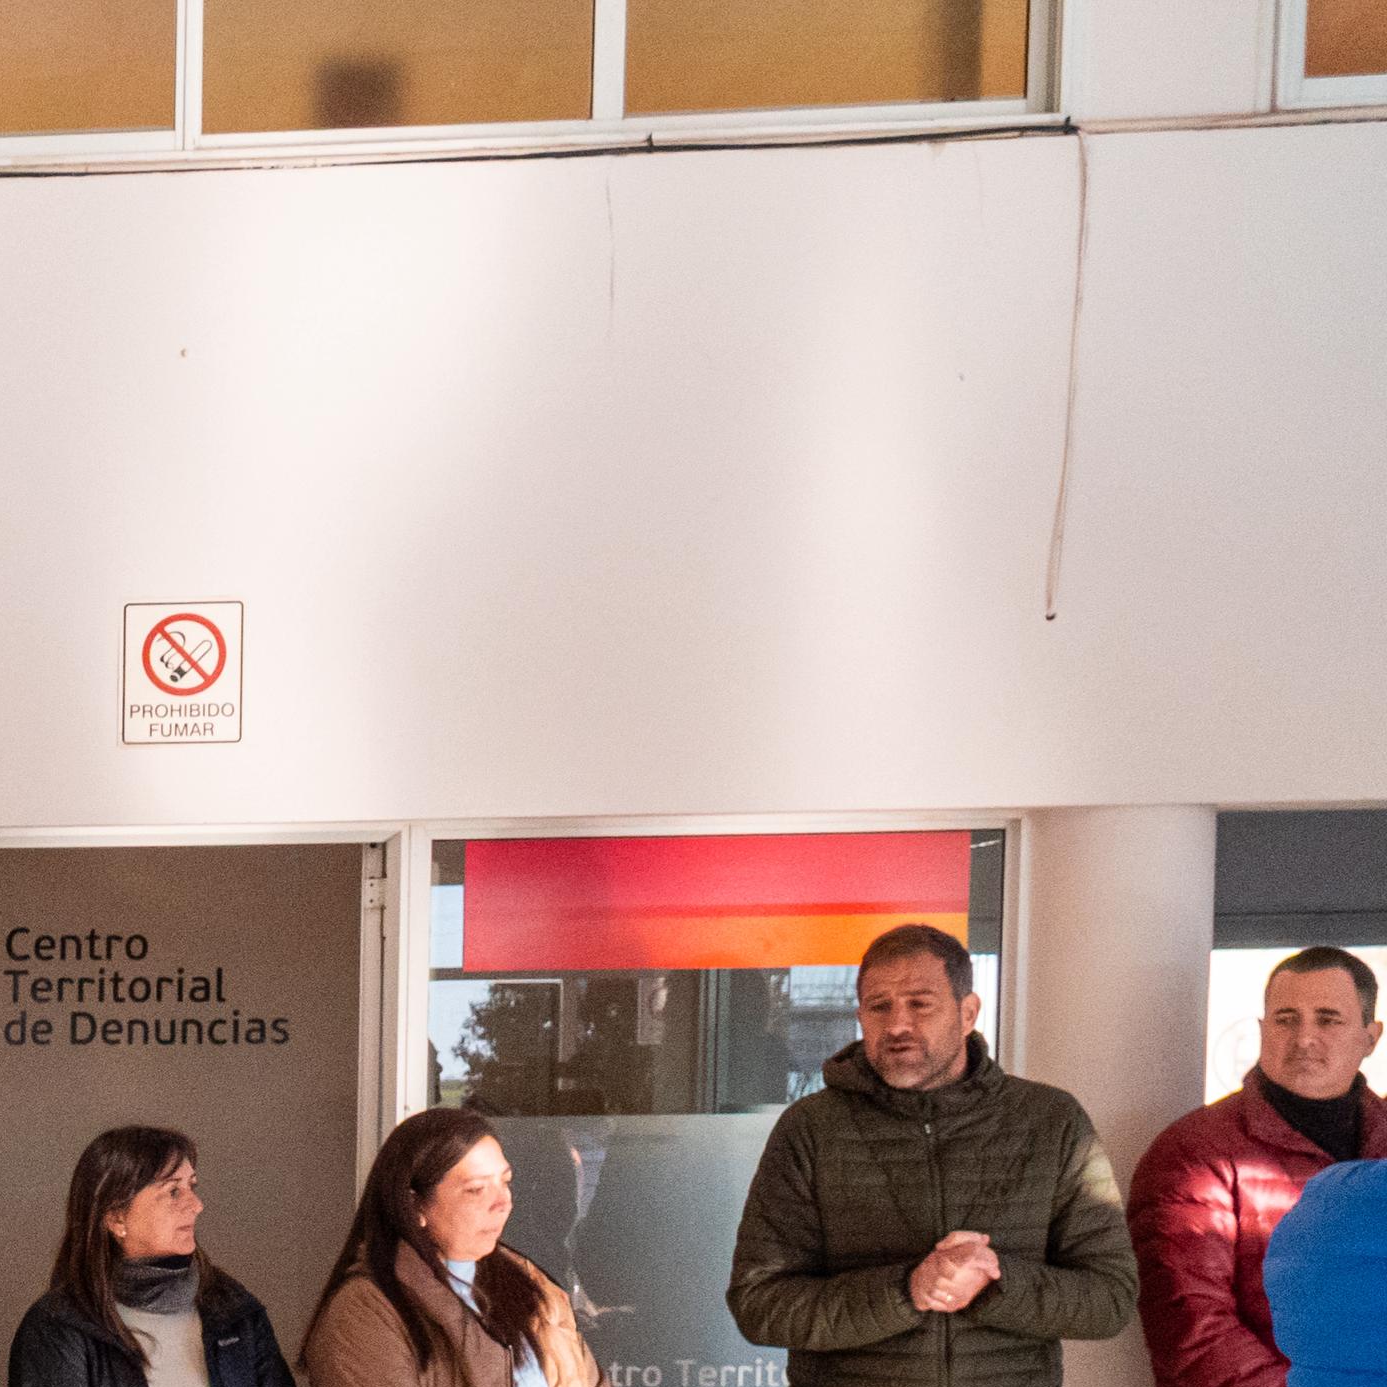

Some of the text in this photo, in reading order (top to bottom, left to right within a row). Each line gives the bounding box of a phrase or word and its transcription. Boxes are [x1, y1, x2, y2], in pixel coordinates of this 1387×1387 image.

[129, 702, 235, 719] PROHIBIDO
[148, 722, 215, 738] FUMAR
[4, 926, 149, 961] Centro
[3, 966, 227, 1003] Territorial
[2, 1008, 291, 1046] de Denuncias
[609, 1360, 663, 1387] tro
